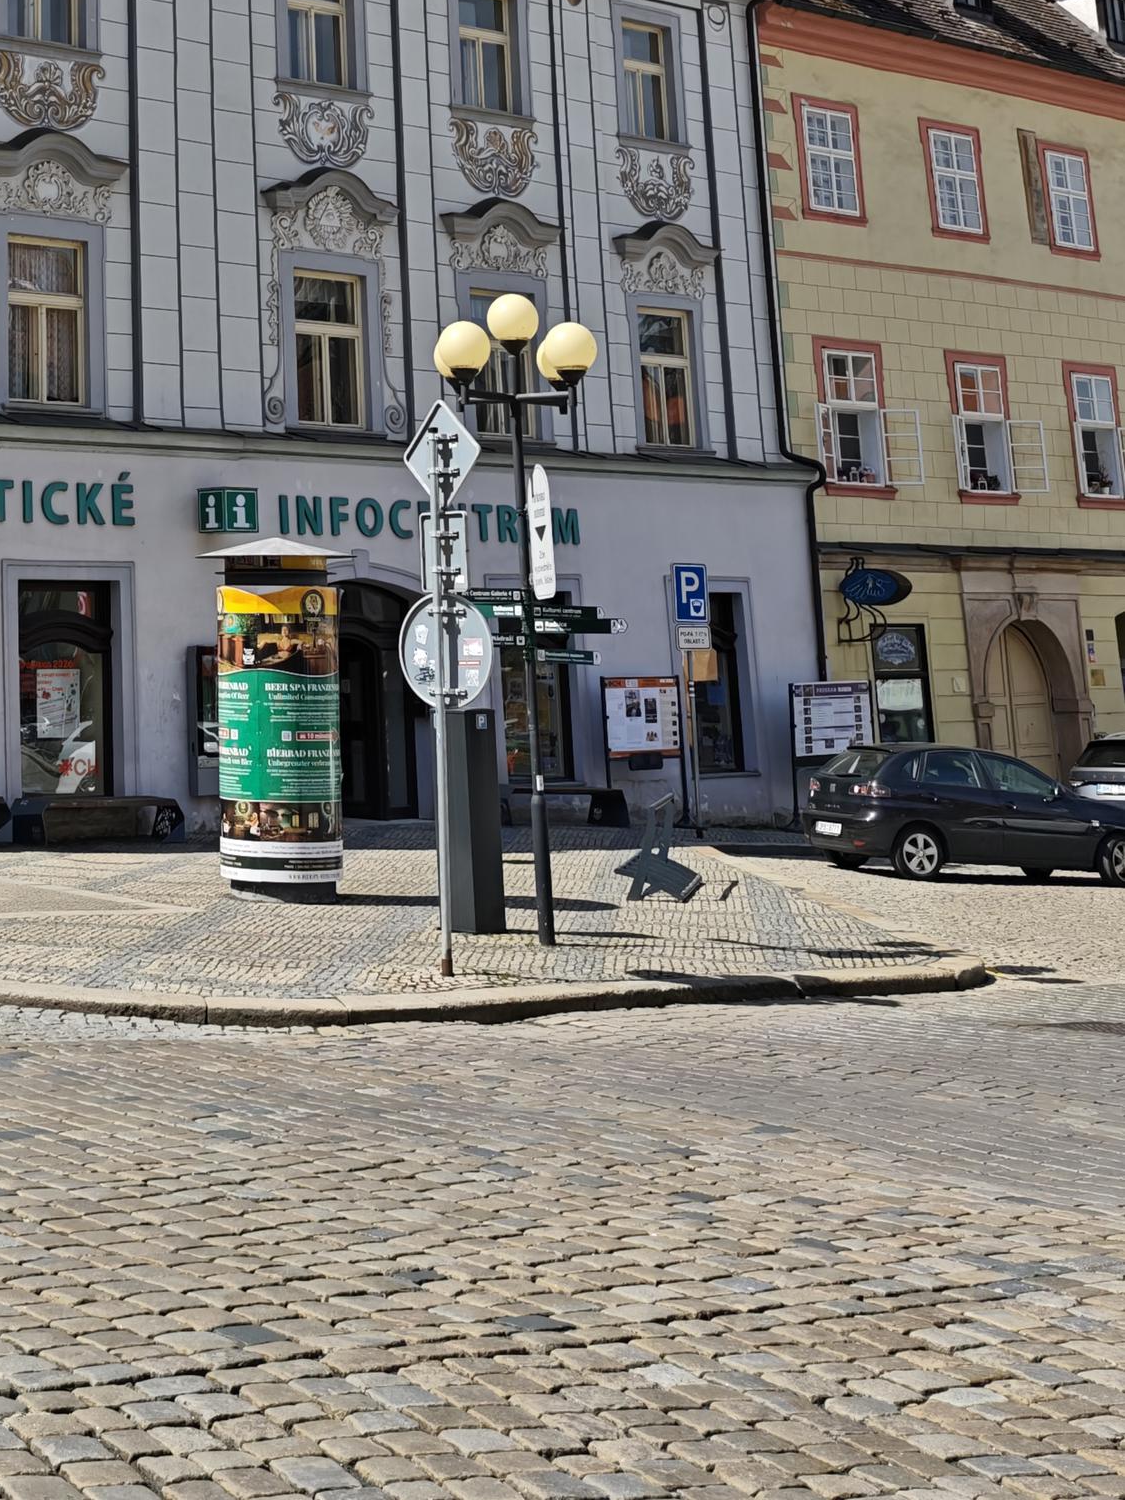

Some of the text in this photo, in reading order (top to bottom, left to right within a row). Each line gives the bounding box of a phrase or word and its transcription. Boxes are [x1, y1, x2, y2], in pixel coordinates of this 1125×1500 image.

[278, 494, 581, 546] INFOCTRM
[265, 682, 288, 691] BEER
[289, 682, 306, 691] SPA
